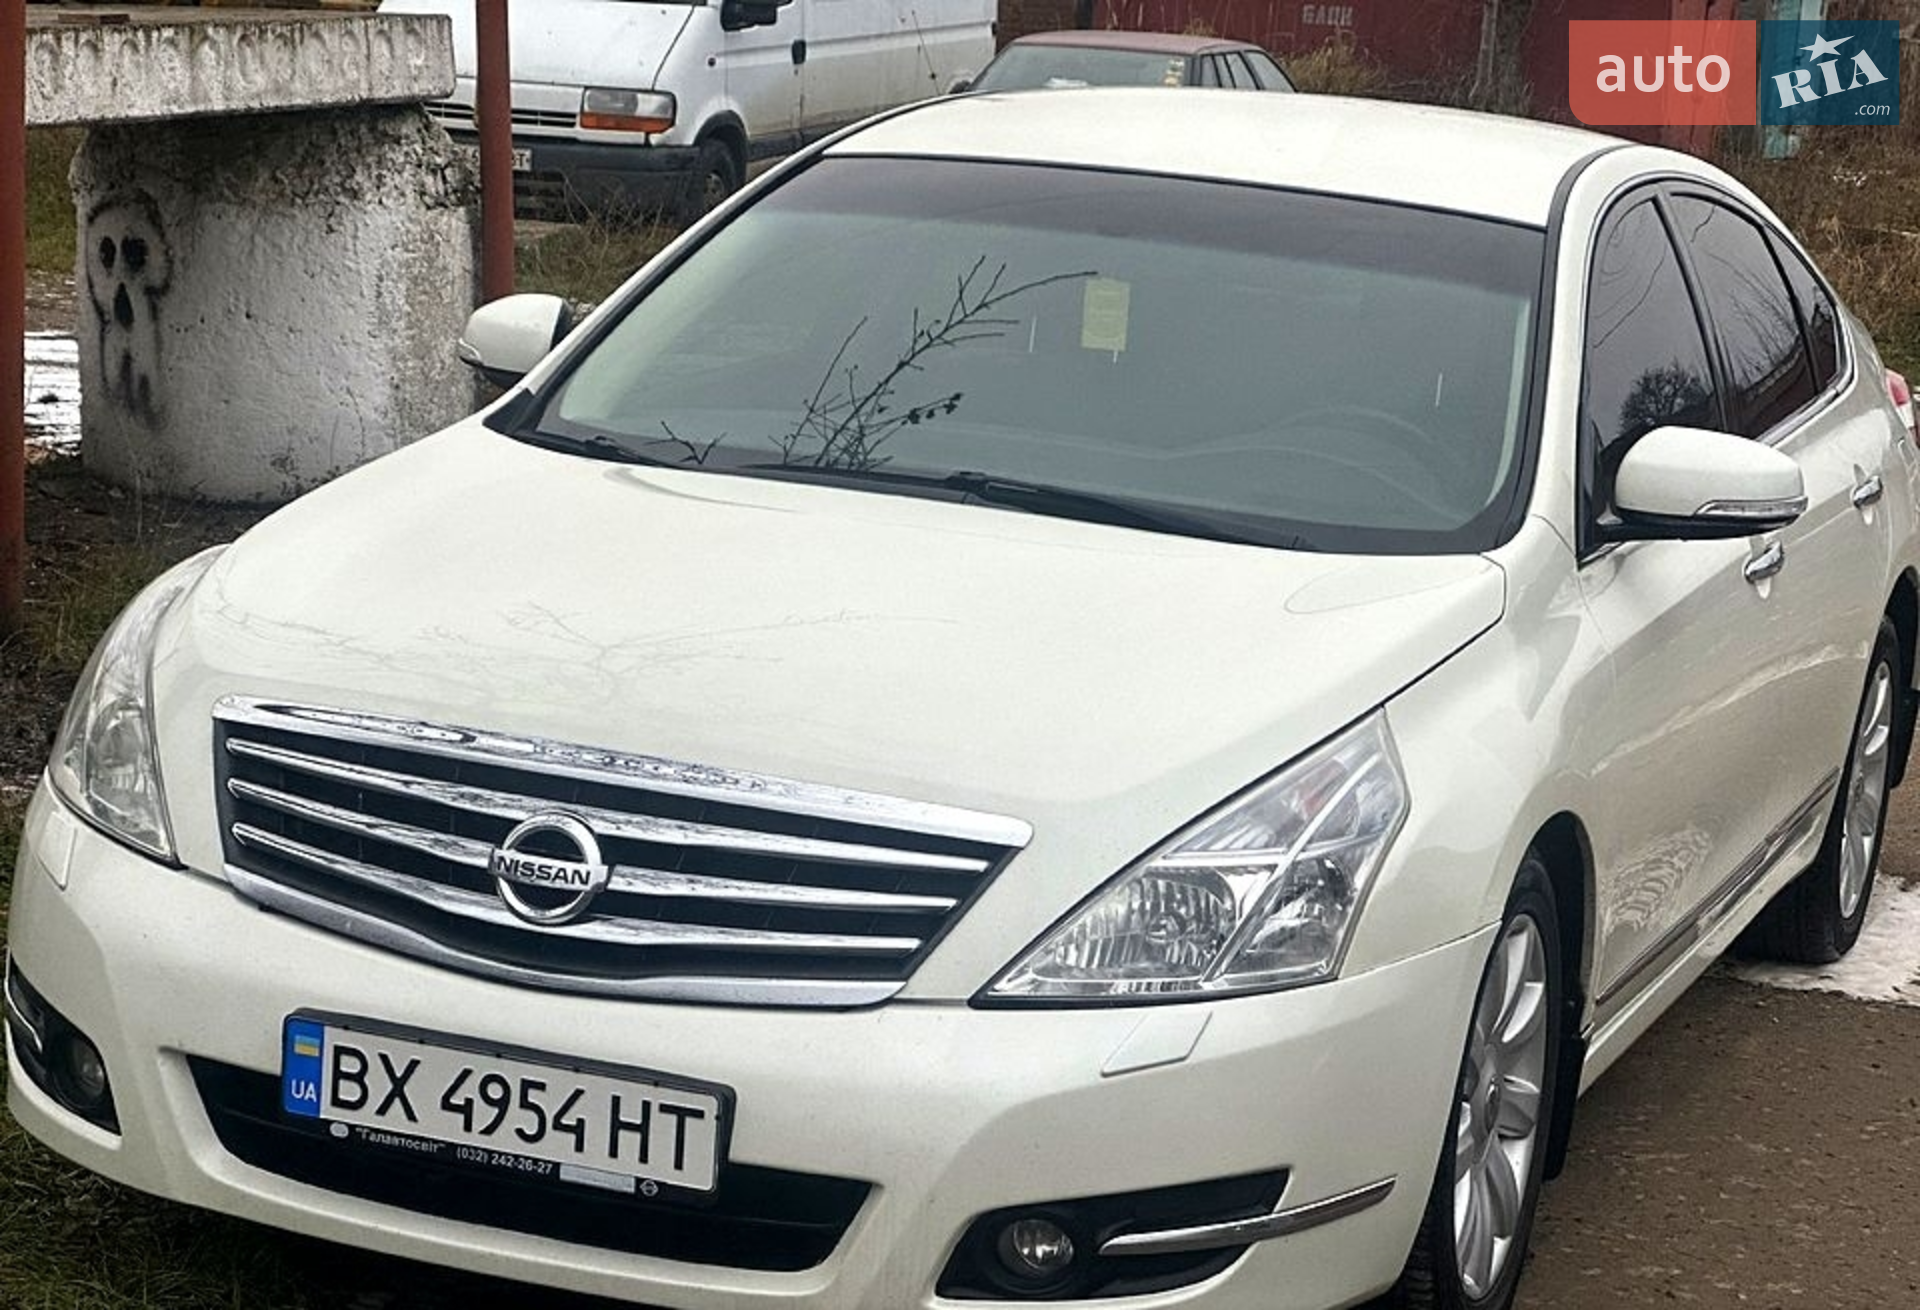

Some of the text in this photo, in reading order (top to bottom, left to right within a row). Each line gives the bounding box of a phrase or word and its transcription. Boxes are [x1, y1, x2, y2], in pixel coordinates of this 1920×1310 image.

[497, 855, 591, 885] NISSAN
[291, 1080, 317, 1102] UA
[331, 1046, 705, 1171] BX 4954 HT
[456, 1146, 488, 1164] (032)
[491, 1153, 552, 1175] 242-26-27
